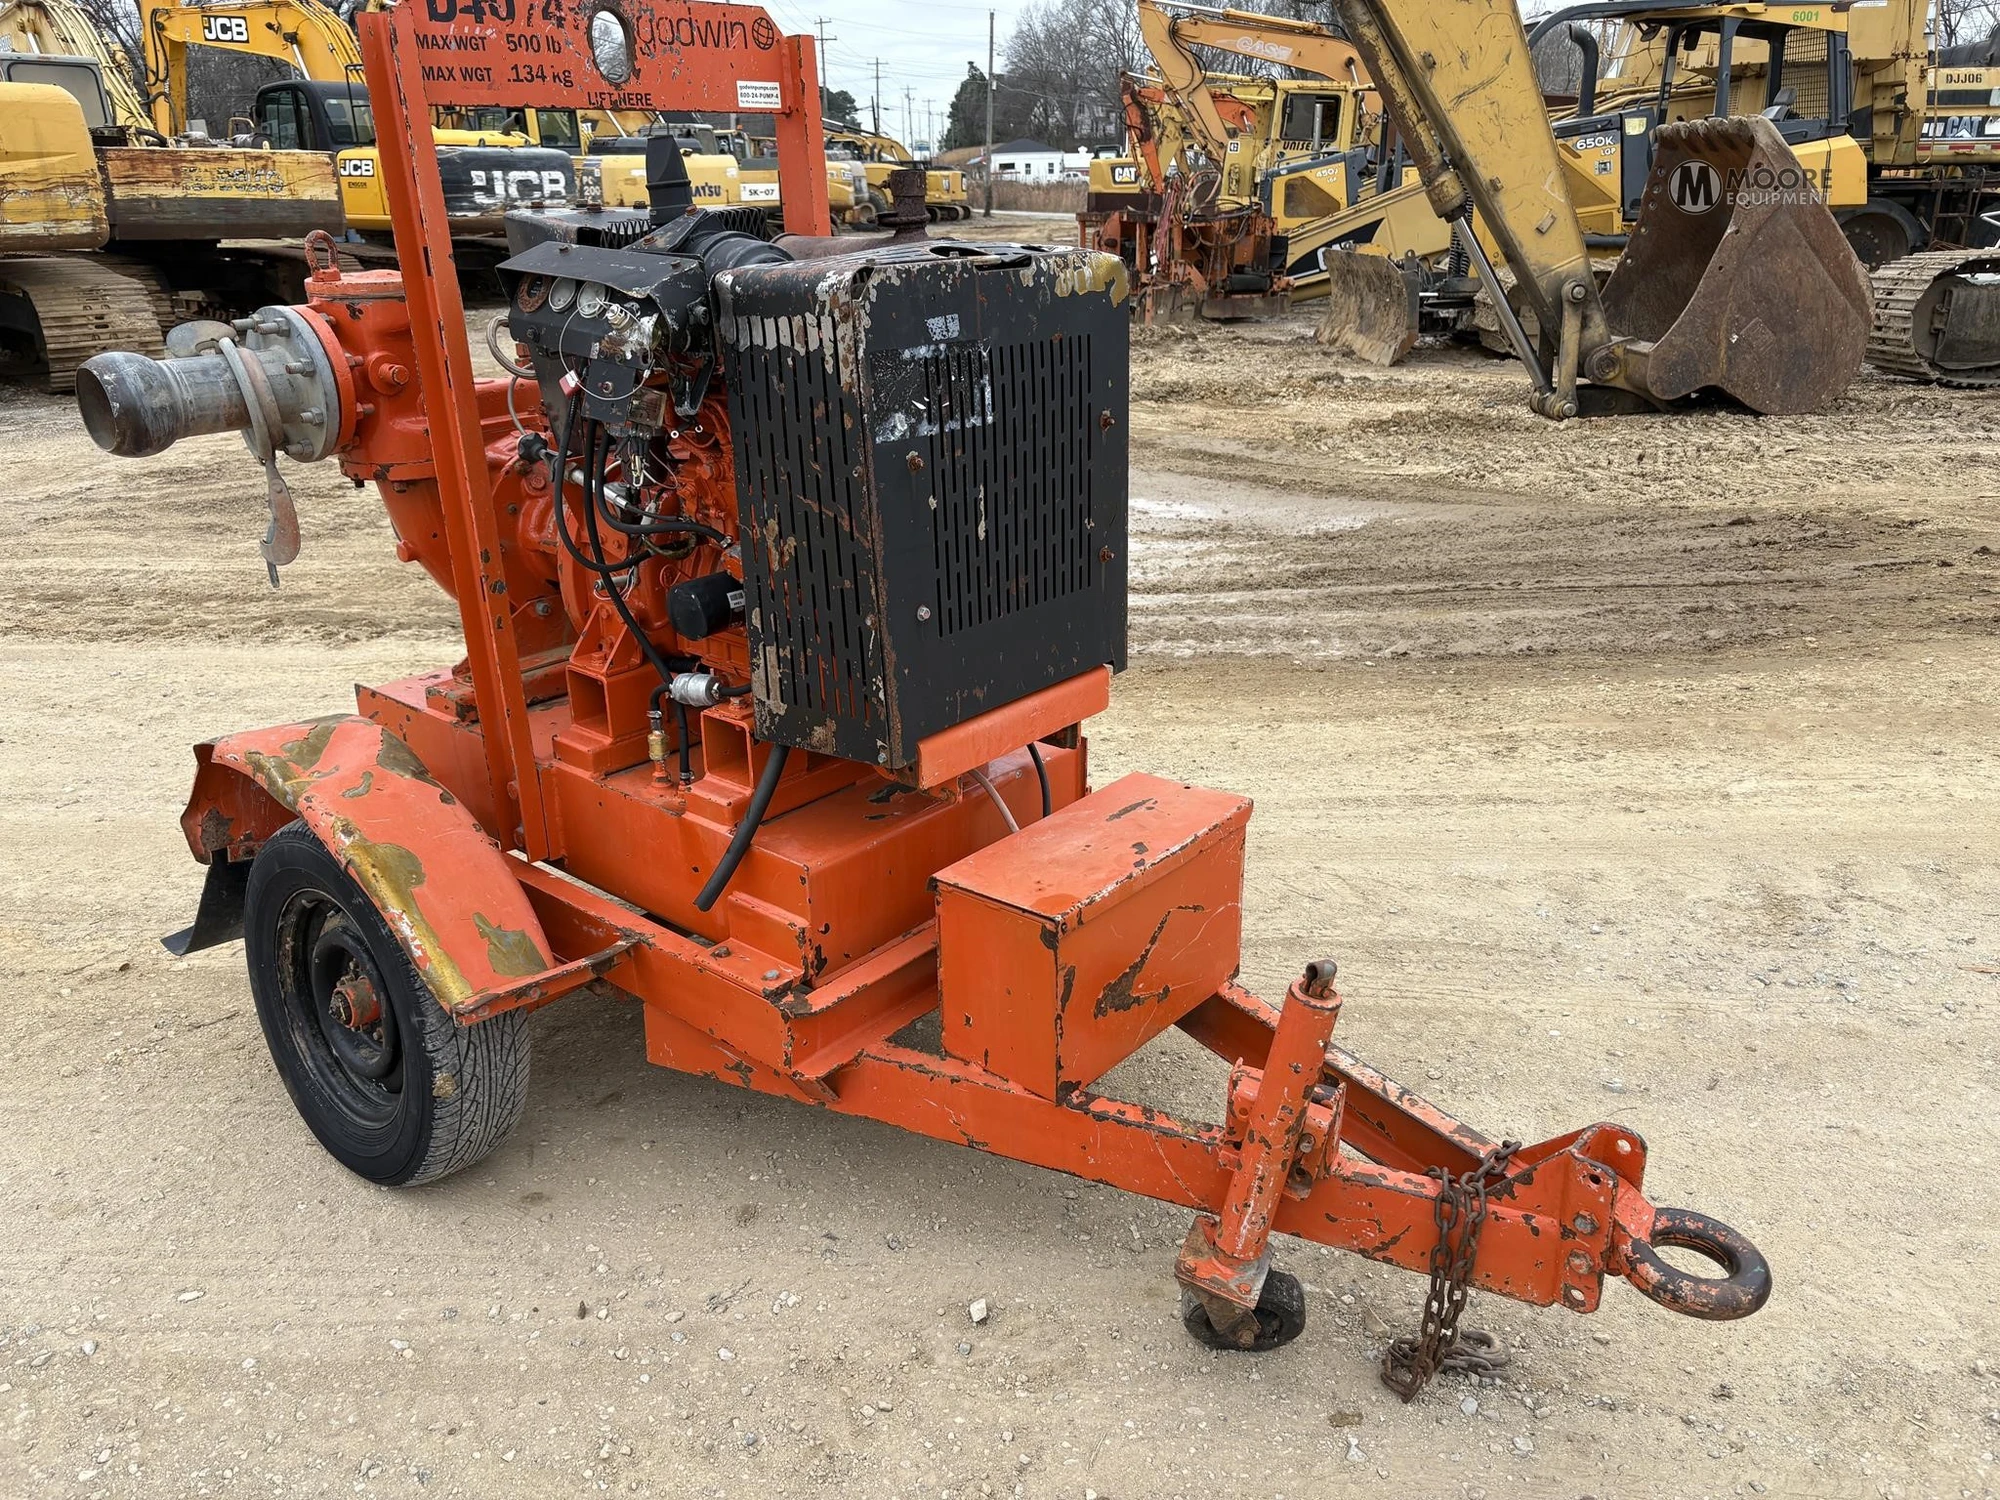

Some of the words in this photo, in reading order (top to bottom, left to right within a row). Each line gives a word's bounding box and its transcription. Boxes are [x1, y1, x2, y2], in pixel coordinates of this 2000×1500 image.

[1793, 11, 1819, 22] 6001
[203, 16, 248, 41] JCB
[636, 7, 748, 56] godwin
[415, 34, 450, 50] MAX
[453, 36, 487, 51] WGT
[506, 34, 542, 53] 500
[545, 35, 562, 54] lb
[1236, 36, 1293, 62] CASE
[421, 66, 457, 82] MAX
[460, 67, 492, 82] WGT
[1946, 73, 1982, 84] DJJ06
[587, 91, 614, 108] LIFT
[1945, 116, 1983, 138] CAT
[1576, 136, 1614, 150] 650K
[340, 159, 374, 176] JCB
[1114, 167, 1137, 182] CAT
[470, 170, 567, 205] JCB
[583, 185, 601, 196] 200
[692, 184, 721, 197] ATSU
[748, 188, 775, 197] SK-07
